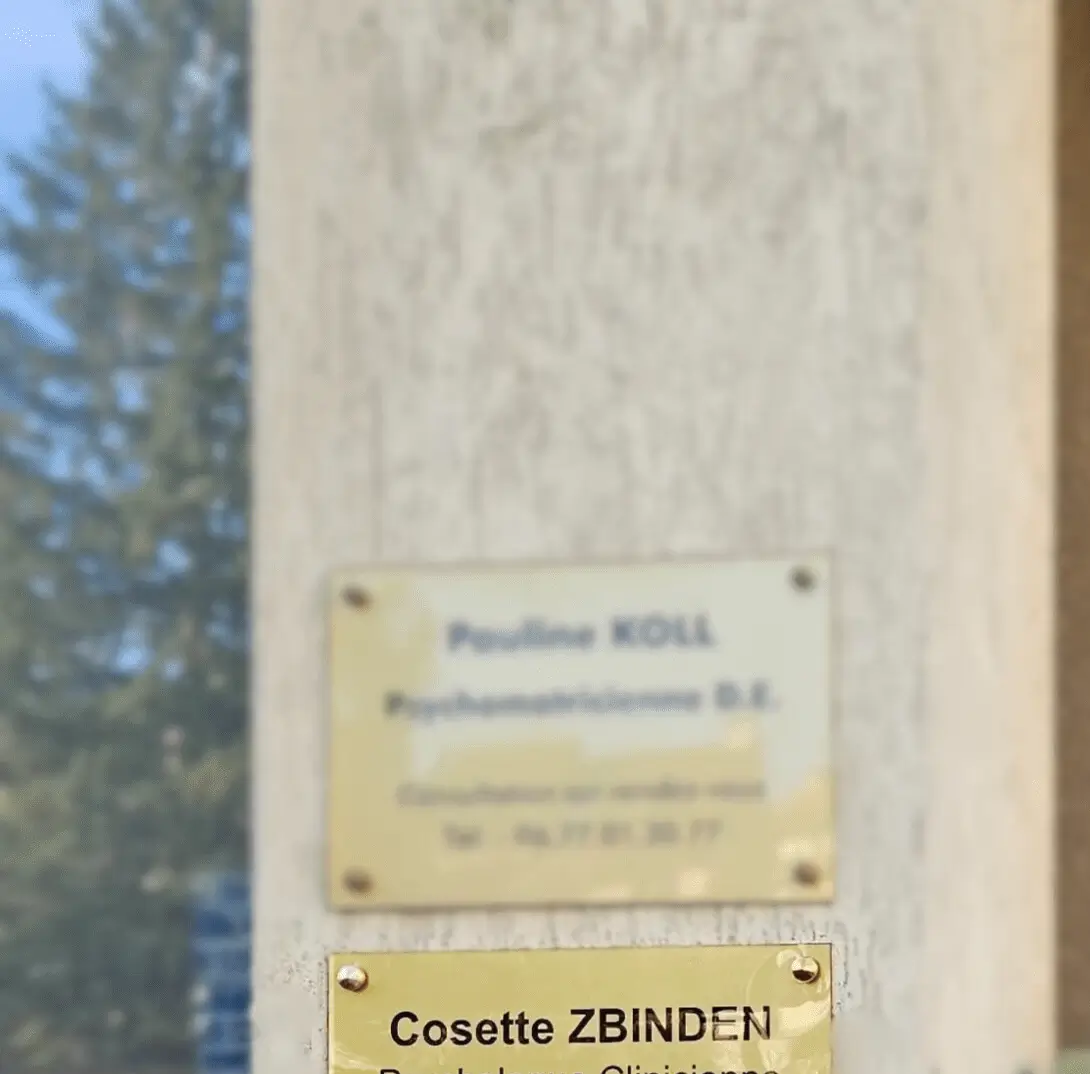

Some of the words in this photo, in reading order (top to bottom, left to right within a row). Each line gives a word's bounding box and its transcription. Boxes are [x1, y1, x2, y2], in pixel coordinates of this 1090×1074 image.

[446, 617, 596, 653] Pauline
[611, 612, 718, 647] KOLL
[390, 1010, 554, 1047] Cosette
[568, 1005, 771, 1043] ZBINDEN
